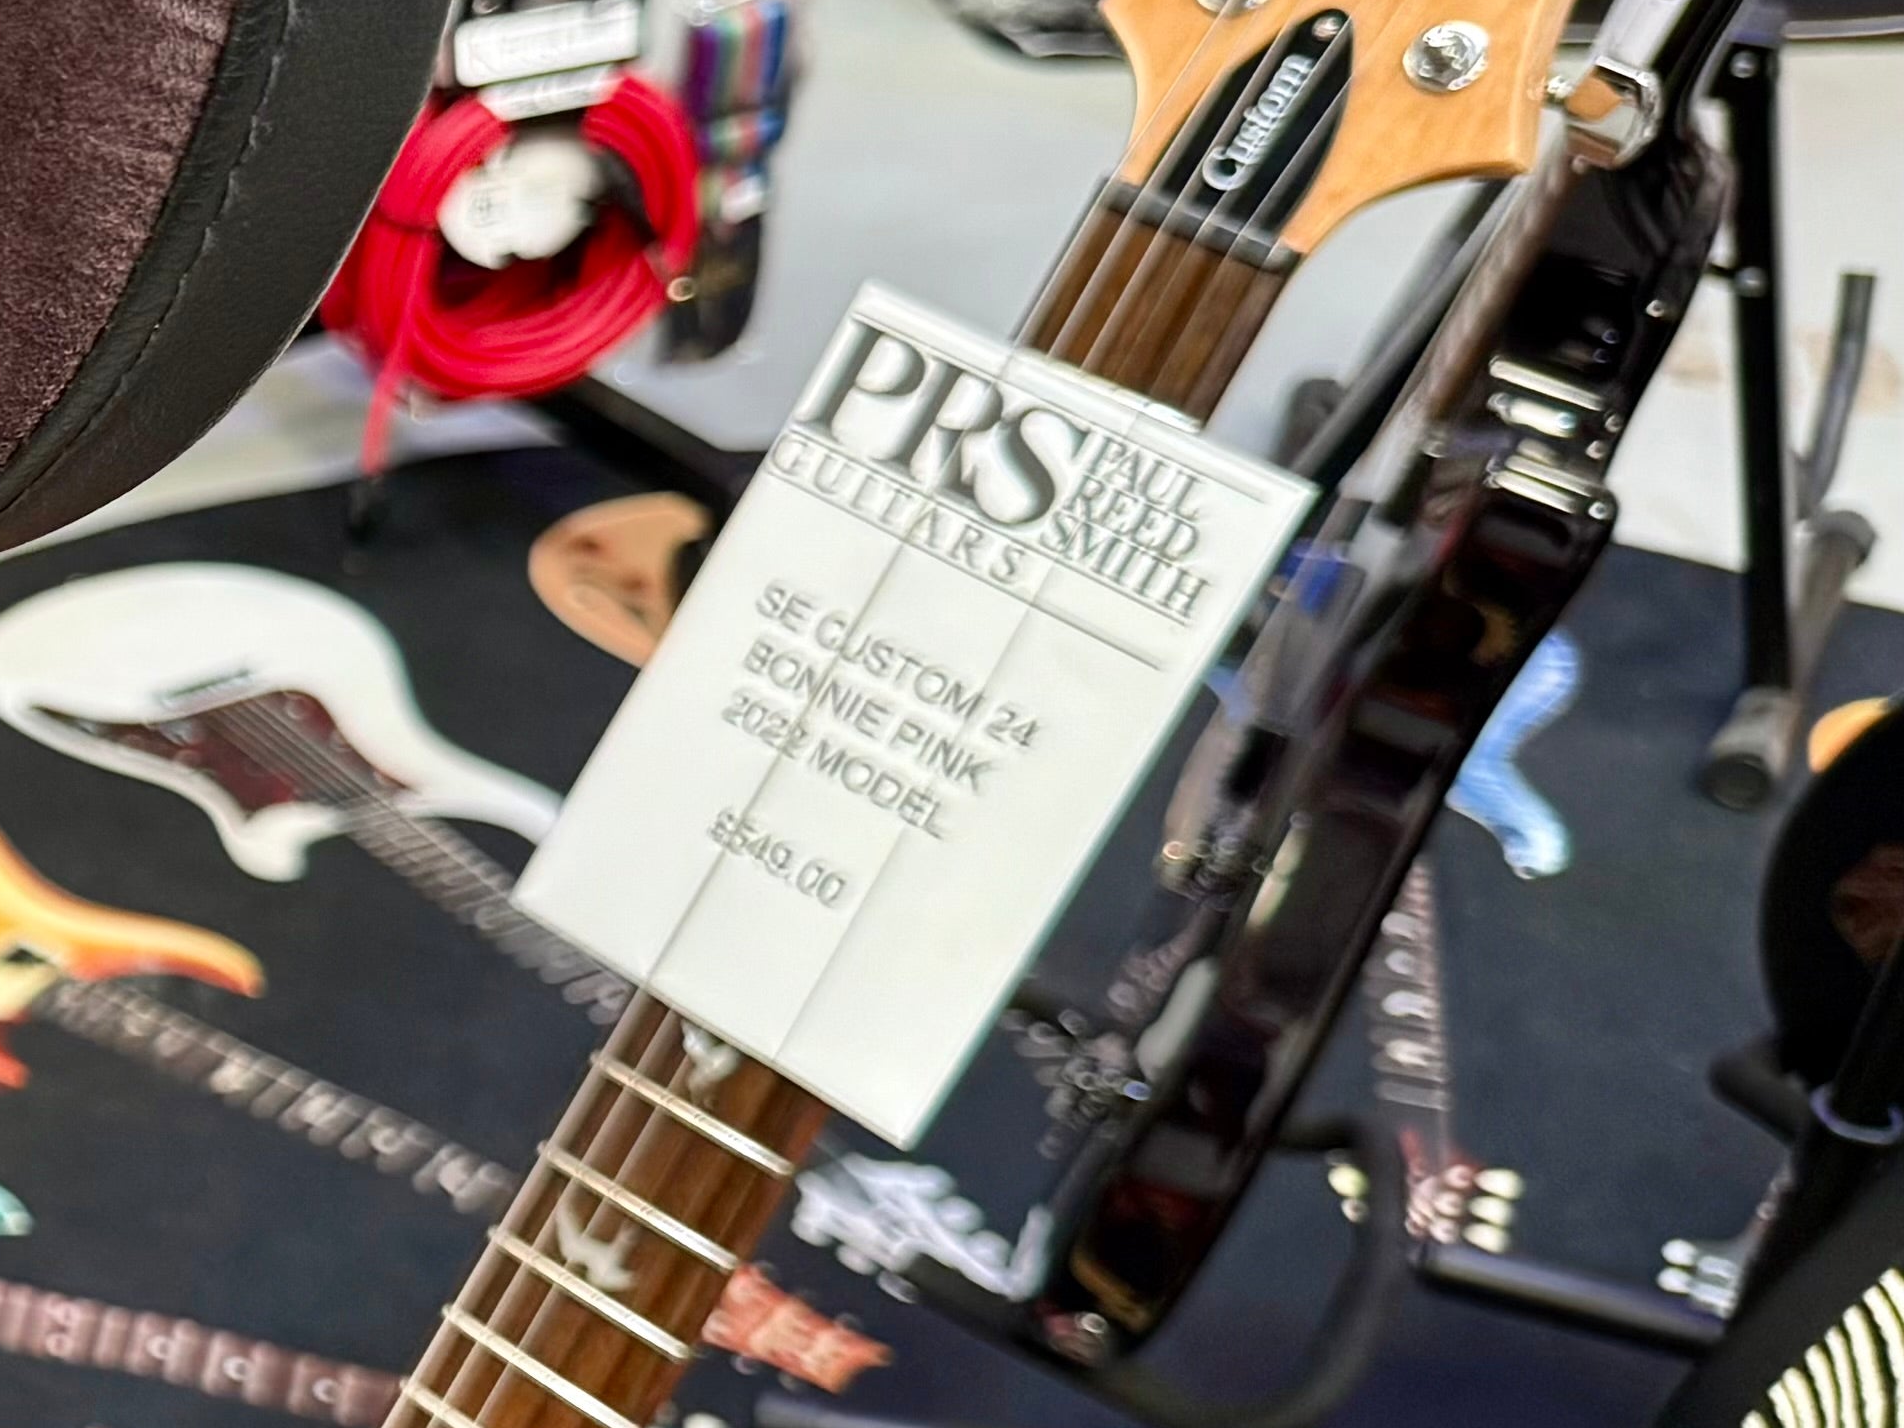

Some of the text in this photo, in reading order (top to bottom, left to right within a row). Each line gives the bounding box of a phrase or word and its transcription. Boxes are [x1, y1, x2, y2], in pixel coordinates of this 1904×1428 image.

[1201, 53, 1316, 192] Custom
[792, 315, 1090, 525] PRS
[1090, 433, 1203, 522] PAUL
[772, 434, 1029, 585] GUITARS
[1040, 510, 1208, 619] SMITH
[1063, 474, 1201, 561] REED
[743, 636, 992, 794] BONNIE PINK
[754, 579, 1041, 748] SE CUSTOM 24
[721, 688, 944, 841] 2022 MODEL
